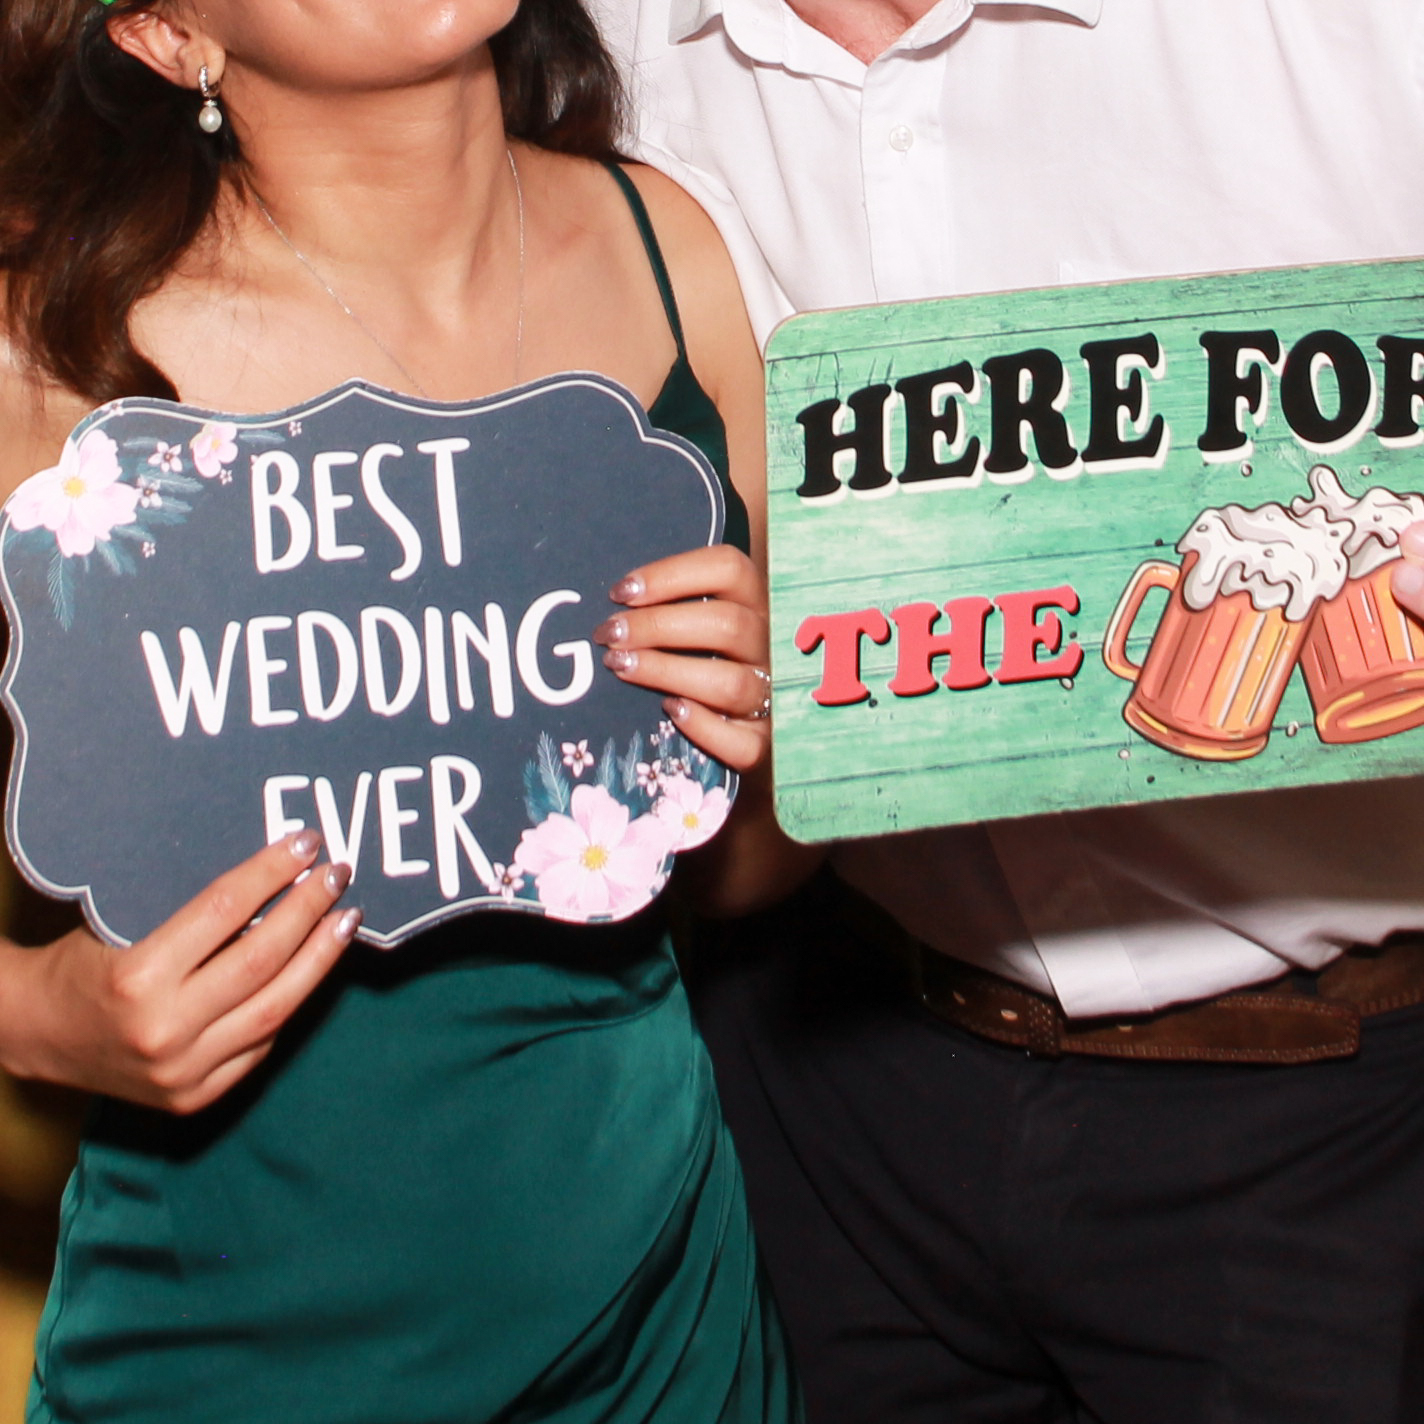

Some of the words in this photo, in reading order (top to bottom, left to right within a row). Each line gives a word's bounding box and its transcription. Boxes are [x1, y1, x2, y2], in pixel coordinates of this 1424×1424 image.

[794, 332, 1168, 499] HERE
[250, 438, 471, 581] BEST
[140, 589, 595, 738] WEDDING
[794, 584, 1084, 707] THE
[263, 754, 496, 899] EVER
